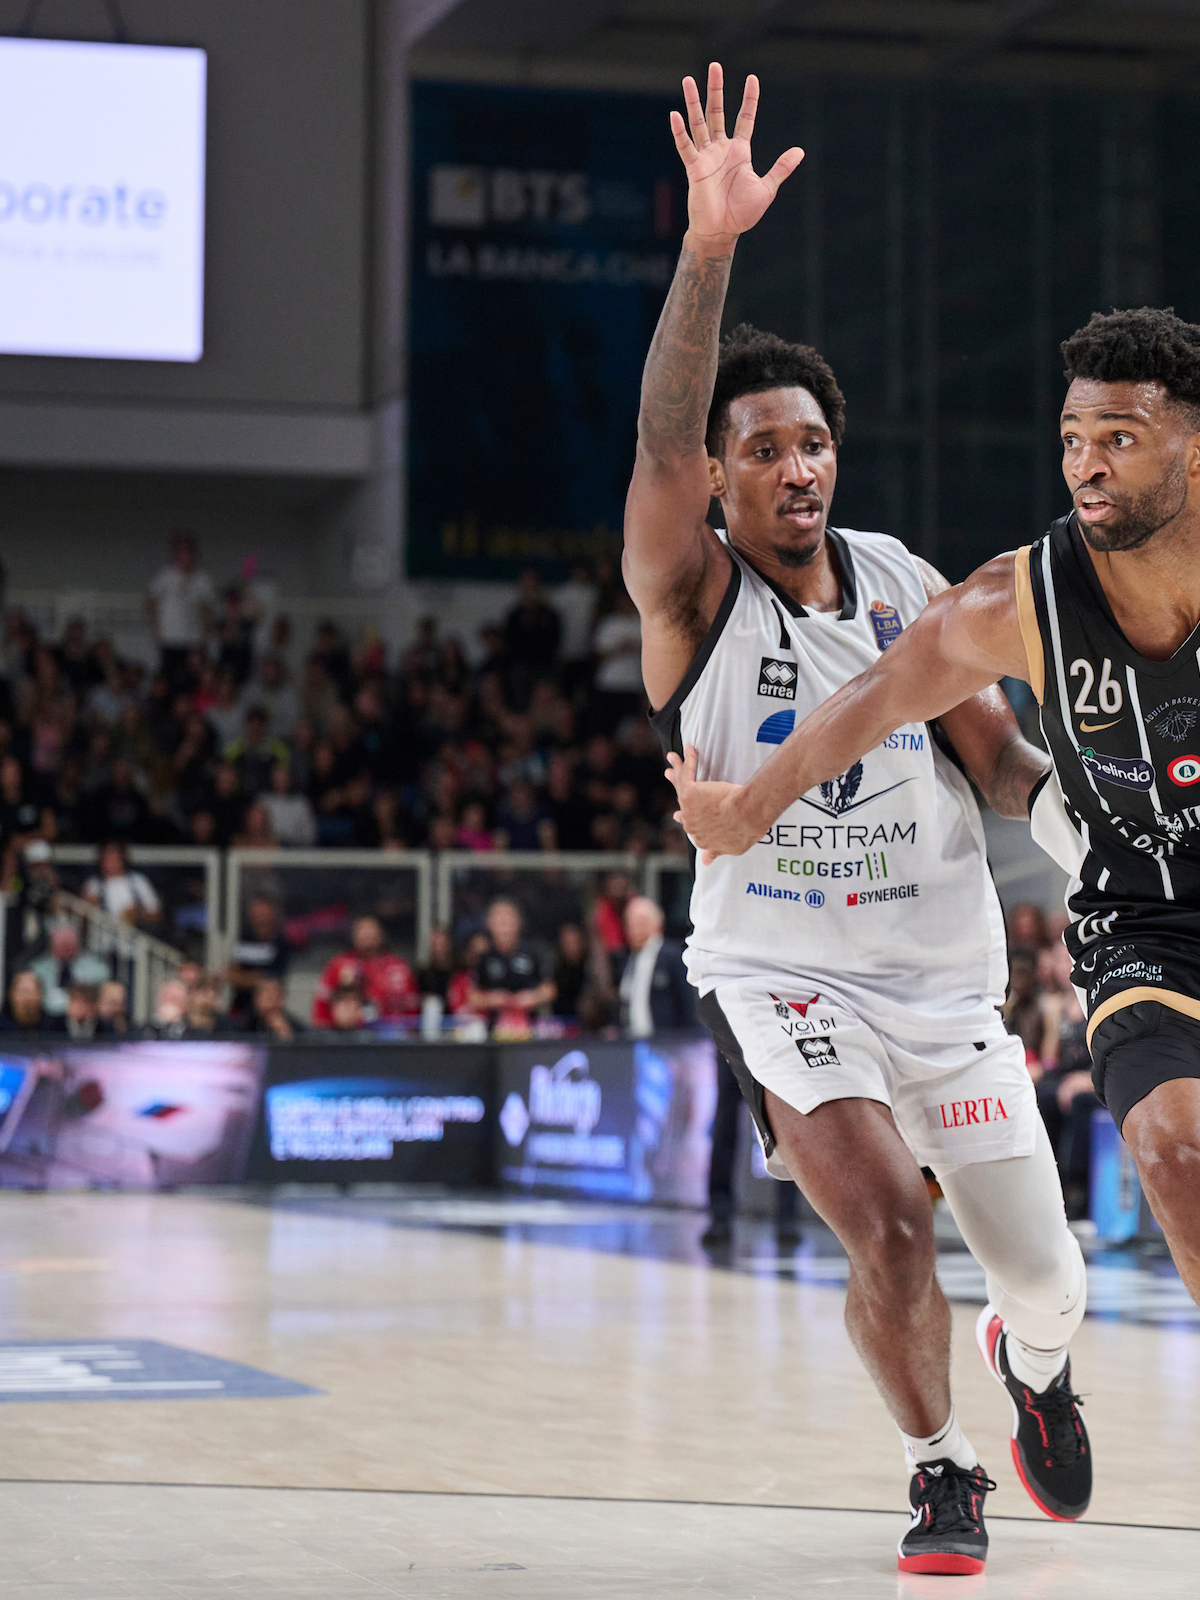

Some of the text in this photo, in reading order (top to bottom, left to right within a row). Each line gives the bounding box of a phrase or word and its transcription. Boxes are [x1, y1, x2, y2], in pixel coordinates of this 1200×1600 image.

[877, 619, 899, 631] LBA
[759, 683, 795, 699] errea
[1070, 657, 1123, 715] 26
[1144, 701, 1170, 724] AQUILA
[1081, 755, 1151, 783] Melinda
[1183, 765, 1193, 778] A
[758, 822, 917, 849] BERTRAM
[777, 858, 864, 879] ECOGEST
[746, 882, 801, 902] Allianz
[859, 884, 919, 904] SYNERGIE
[1104, 944, 1136, 967] TRENTO
[940, 1097, 1009, 1129] LERTA
